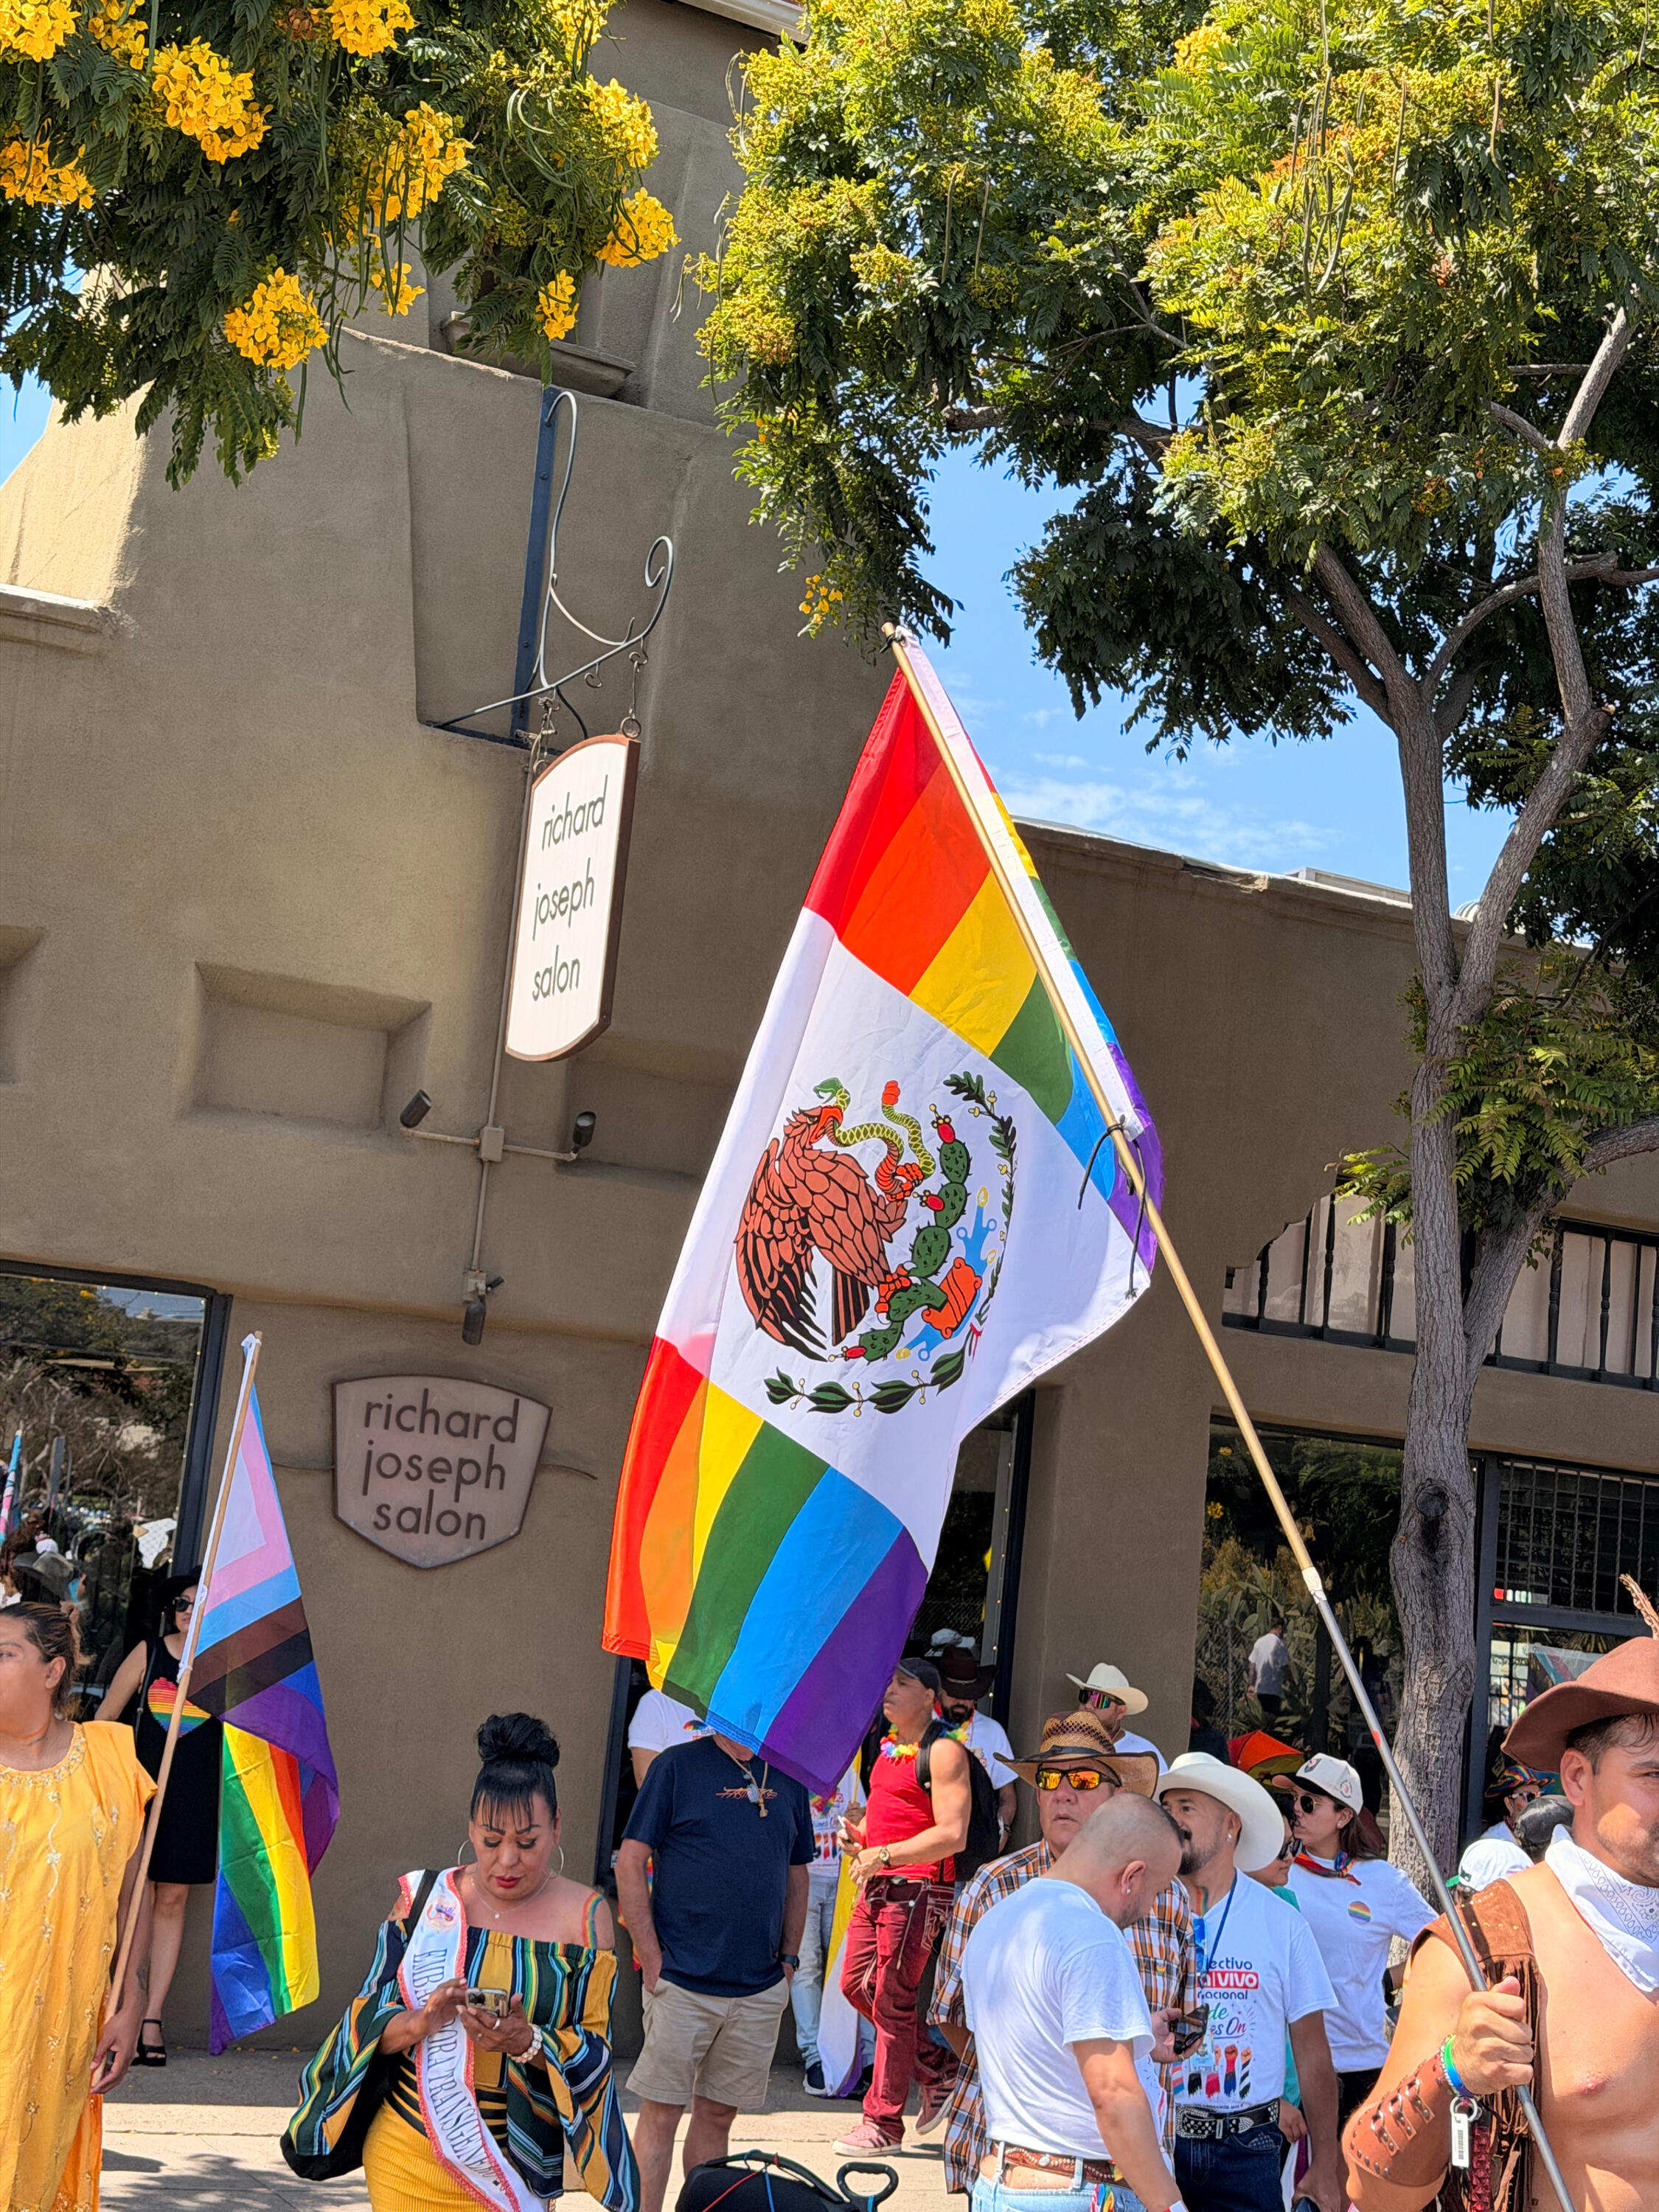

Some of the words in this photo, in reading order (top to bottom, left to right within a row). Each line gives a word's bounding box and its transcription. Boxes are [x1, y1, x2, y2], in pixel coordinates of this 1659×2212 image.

[541, 774, 608, 851] richard
[532, 857, 595, 941] joseph
[532, 945, 581, 1002] salon
[364, 1388, 520, 1444] richard
[362, 1440, 506, 1503] joseph
[372, 1489, 486, 1540] salon
[412, 1948, 458, 2071] EMBAORA
[1225, 2017, 1248, 2036] On
